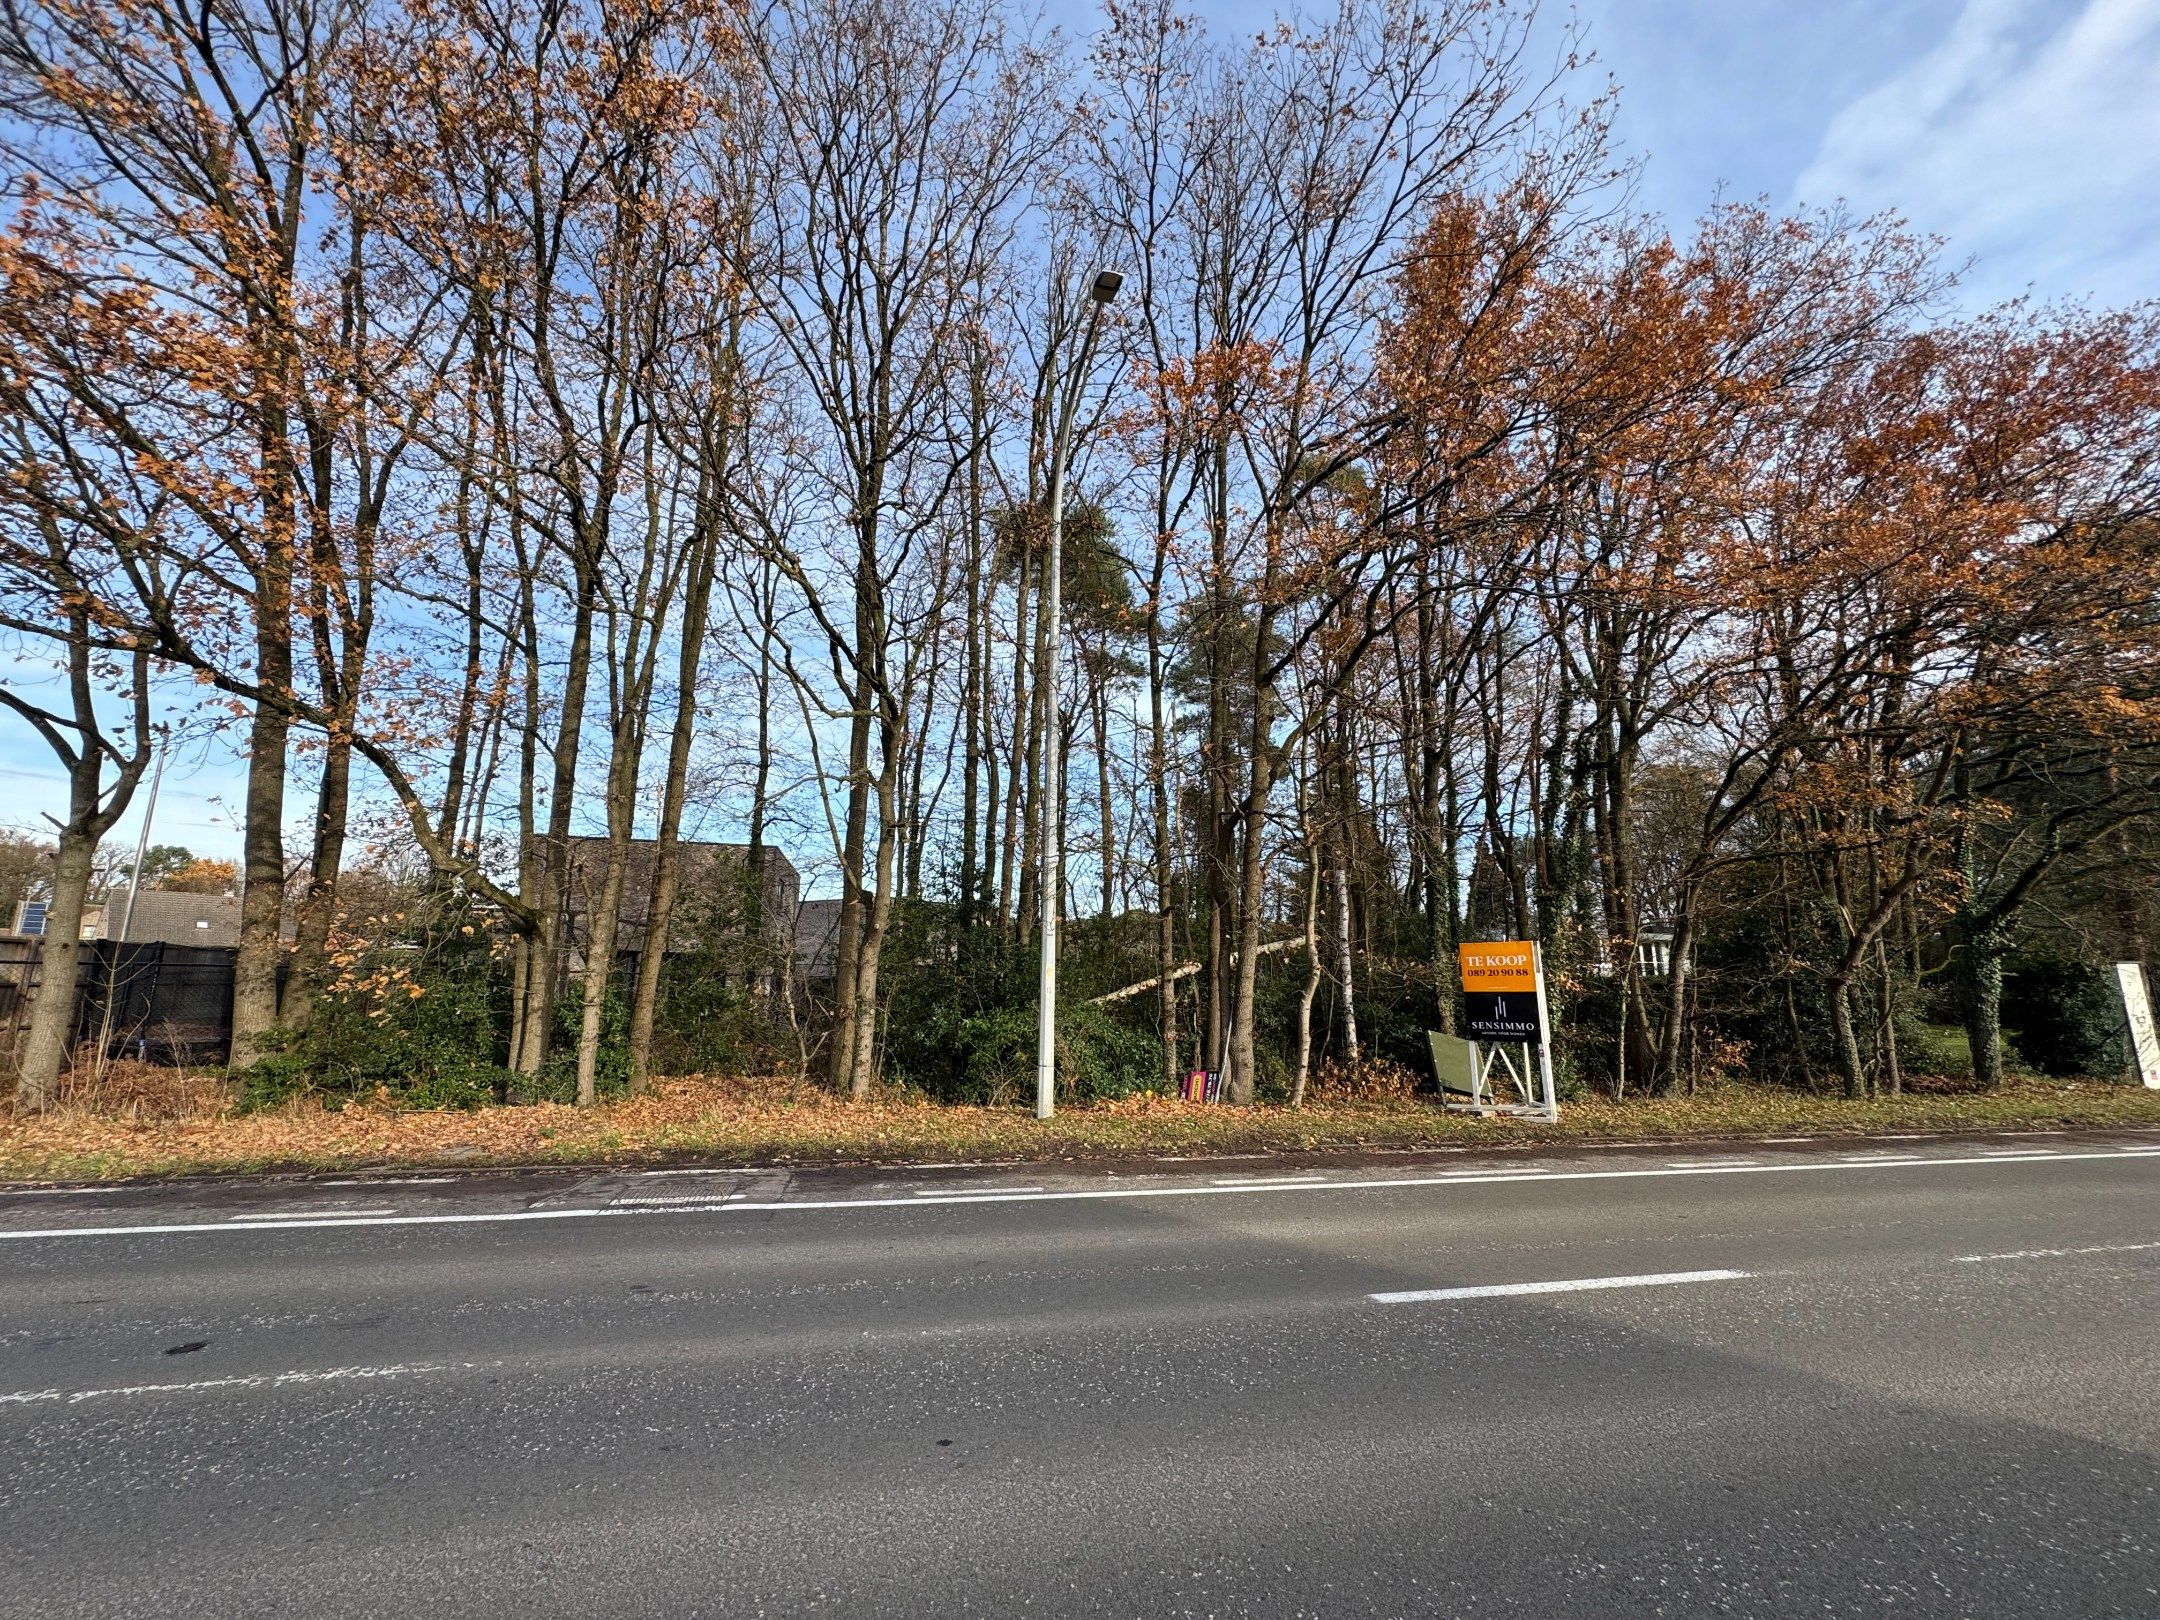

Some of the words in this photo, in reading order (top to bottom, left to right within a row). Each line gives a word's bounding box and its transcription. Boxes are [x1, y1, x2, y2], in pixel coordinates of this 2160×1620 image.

[1466, 956, 1483, 967] TE
[1486, 955, 1527, 967] KOOP
[1468, 969, 1486, 977] 089
[1487, 969, 1499, 977] 20
[1501, 968, 1514, 976] 90
[1516, 968, 1529, 976] 88
[1471, 1021, 1535, 1031] SENSIMMO
